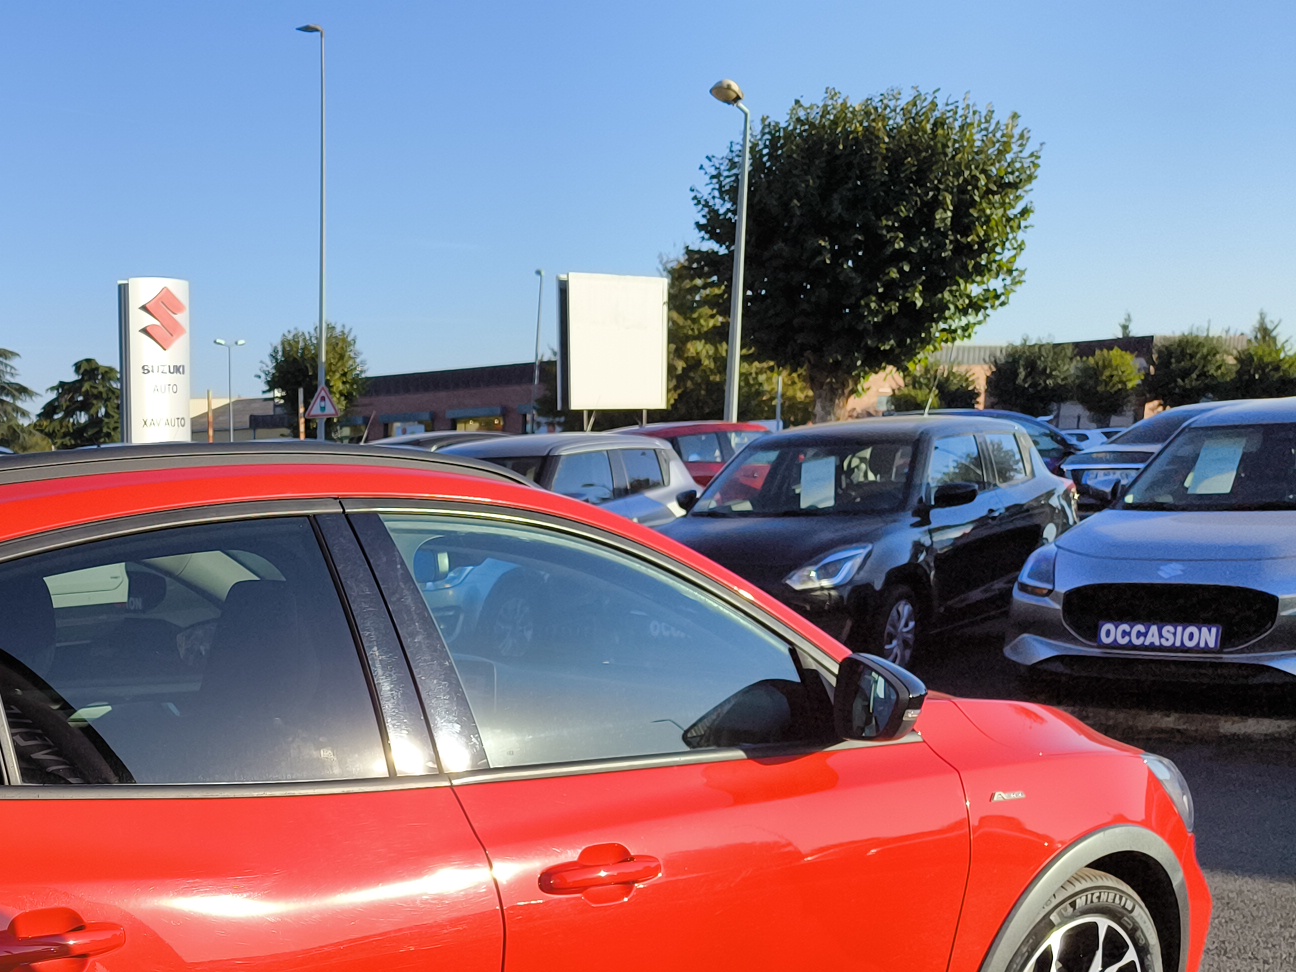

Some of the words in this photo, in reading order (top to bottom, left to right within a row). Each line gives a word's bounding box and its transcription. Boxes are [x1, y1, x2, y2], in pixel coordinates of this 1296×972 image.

[141, 364, 185, 375] SUZUKI
[153, 383, 178, 394] AUTO
[1100, 622, 1218, 648] OCCASION
[1075, 891, 1135, 911] MICHELIN
